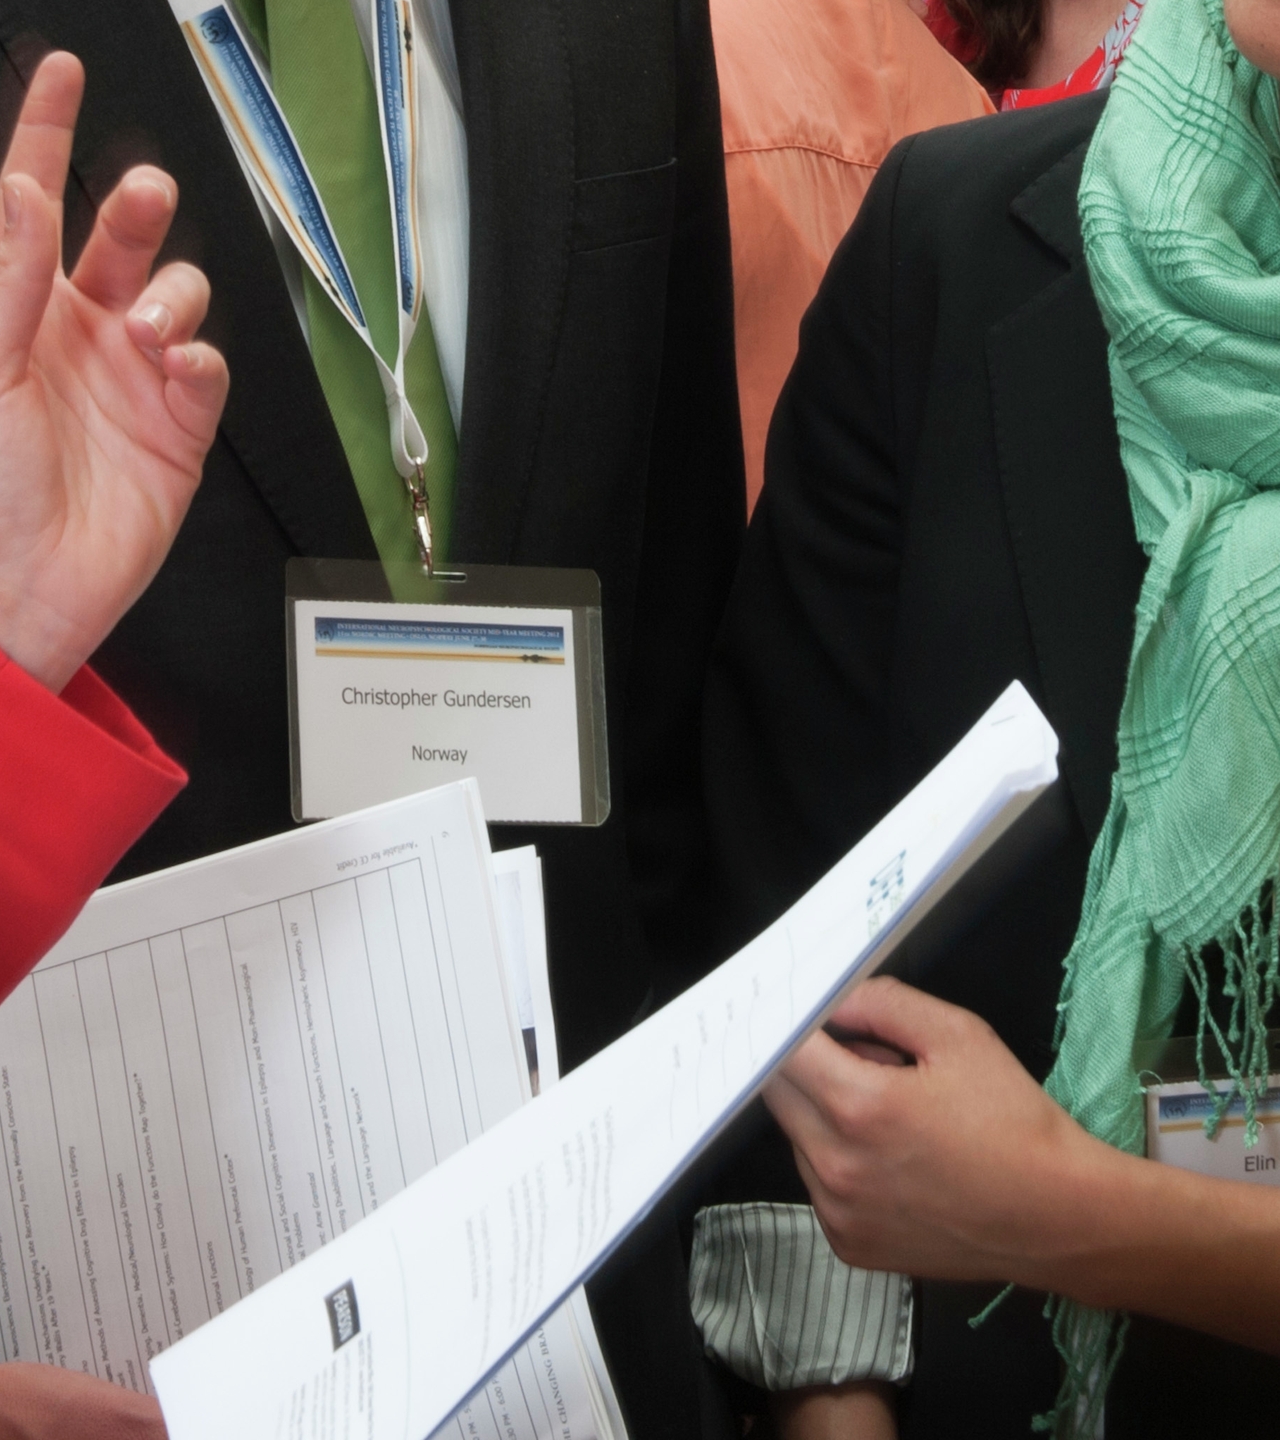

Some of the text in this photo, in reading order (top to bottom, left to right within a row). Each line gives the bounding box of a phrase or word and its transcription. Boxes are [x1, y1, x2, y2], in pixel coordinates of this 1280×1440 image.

[341, 687, 531, 709] Christopher Gundersen
[411, 745, 468, 765] Norway
[301, 984, 313, 1031] Hemispheric
[253, 1046, 262, 1061] and
[257, 1063, 268, 1095] Epilepsy
[315, 1075, 326, 1103] Speech
[5, 1090, 16, 1128] Conscious
[141, 1117, 149, 1133] Map
[320, 1105, 328, 1119] and
[264, 1107, 276, 1152] Dimensions
[324, 1122, 335, 1160] Language
[359, 1126, 370, 1164] Language
[10, 1129, 21, 1167] Minimally
[68, 1146, 79, 1178] Epilepsy
[144, 1135, 155, 1173] Functions
[1244, 1154, 1276, 1173] Elin
[16, 1169, 24, 1182] the
[150, 1175, 158, 1188] the
[271, 1153, 283, 1191] Cognitive
[365, 1166, 373, 1180] the
[19, 1183, 27, 1202] from
[75, 1190, 84, 1217] Effects
[117, 1173, 128, 1209] Disorders
[230, 1185, 242, 1224] Prefrontal
[276, 1192, 287, 1217] Social
[366, 1181, 376, 1196] and
[23, 1204, 33, 1239] Recovery
[79, 1218, 88, 1237] Drug
[154, 1202, 165, 1230] Closely
[281, 1218, 290, 1233] and
[293, 1212, 304, 1248] Problems
[28, 1240, 36, 1258] Late
[121, 1210, 141, 1291] Medical/Neurological
[238, 1226, 247, 1254] Human
[83, 1239, 94, 1277] Cognitive
[163, 1251, 175, 1286] Systems:
[206, 1241, 218, 1279] Functions
[31, 1259, 43, 1302] Underlying
[89, 1277, 101, 1315] Assessing
[39, 1303, 51, 1350] Mechanisms
[50, 1308, 58, 1327] After
[54, 1329, 63, 1353] Wallis
[97, 1328, 109, 1362] Methods
[494, 1386, 511, 1426] PM 6:00
[544, 1359, 568, 1425] CHANGING
